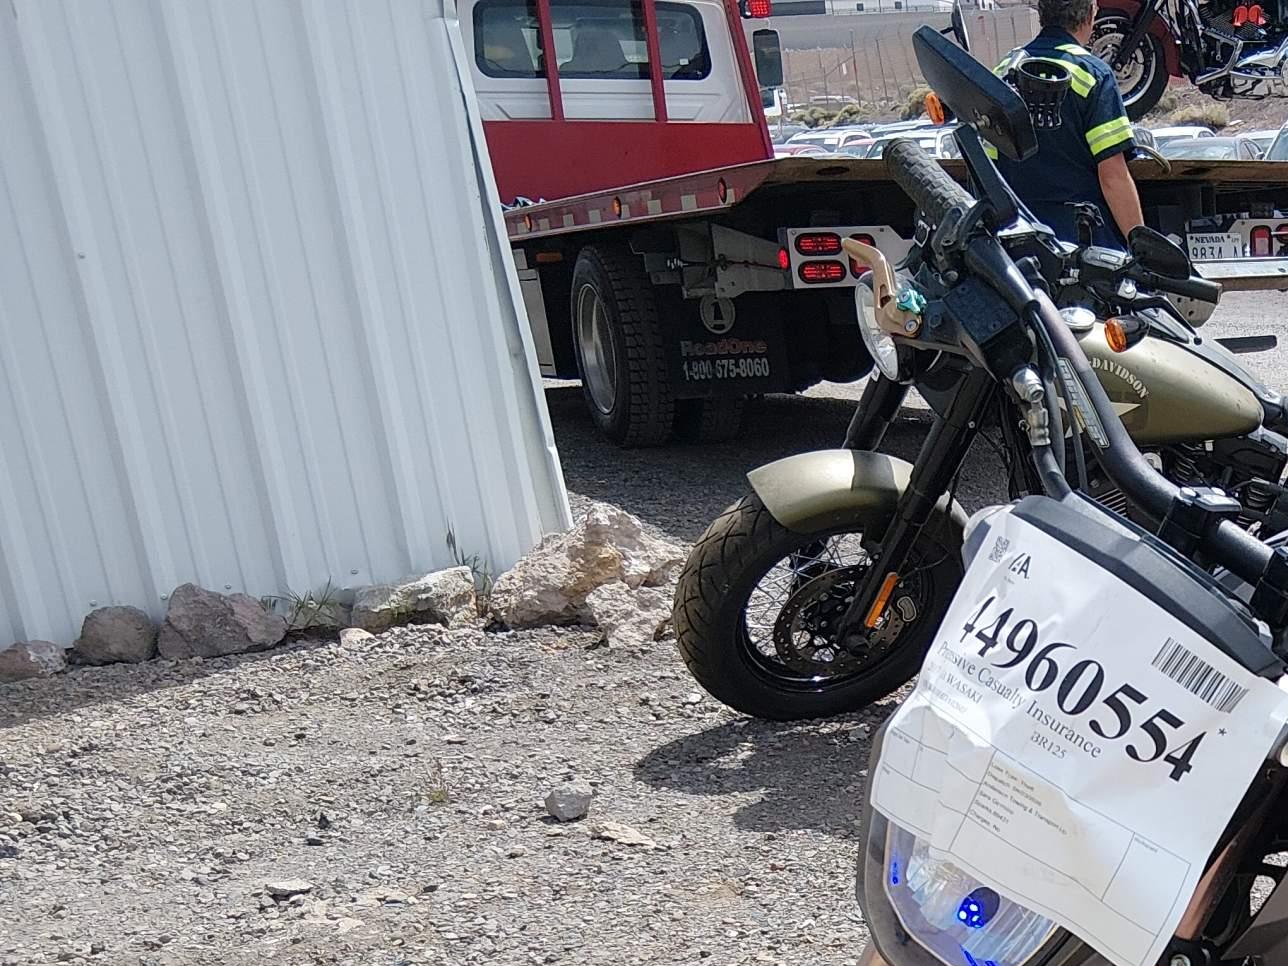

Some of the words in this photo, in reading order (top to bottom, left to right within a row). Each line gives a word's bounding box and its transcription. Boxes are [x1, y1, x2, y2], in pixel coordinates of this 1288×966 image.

[1195, 236, 1225, 244] NEVADA
[978, 667, 1026, 710] Casualty
[1026, 700, 1102, 759] Insurance
